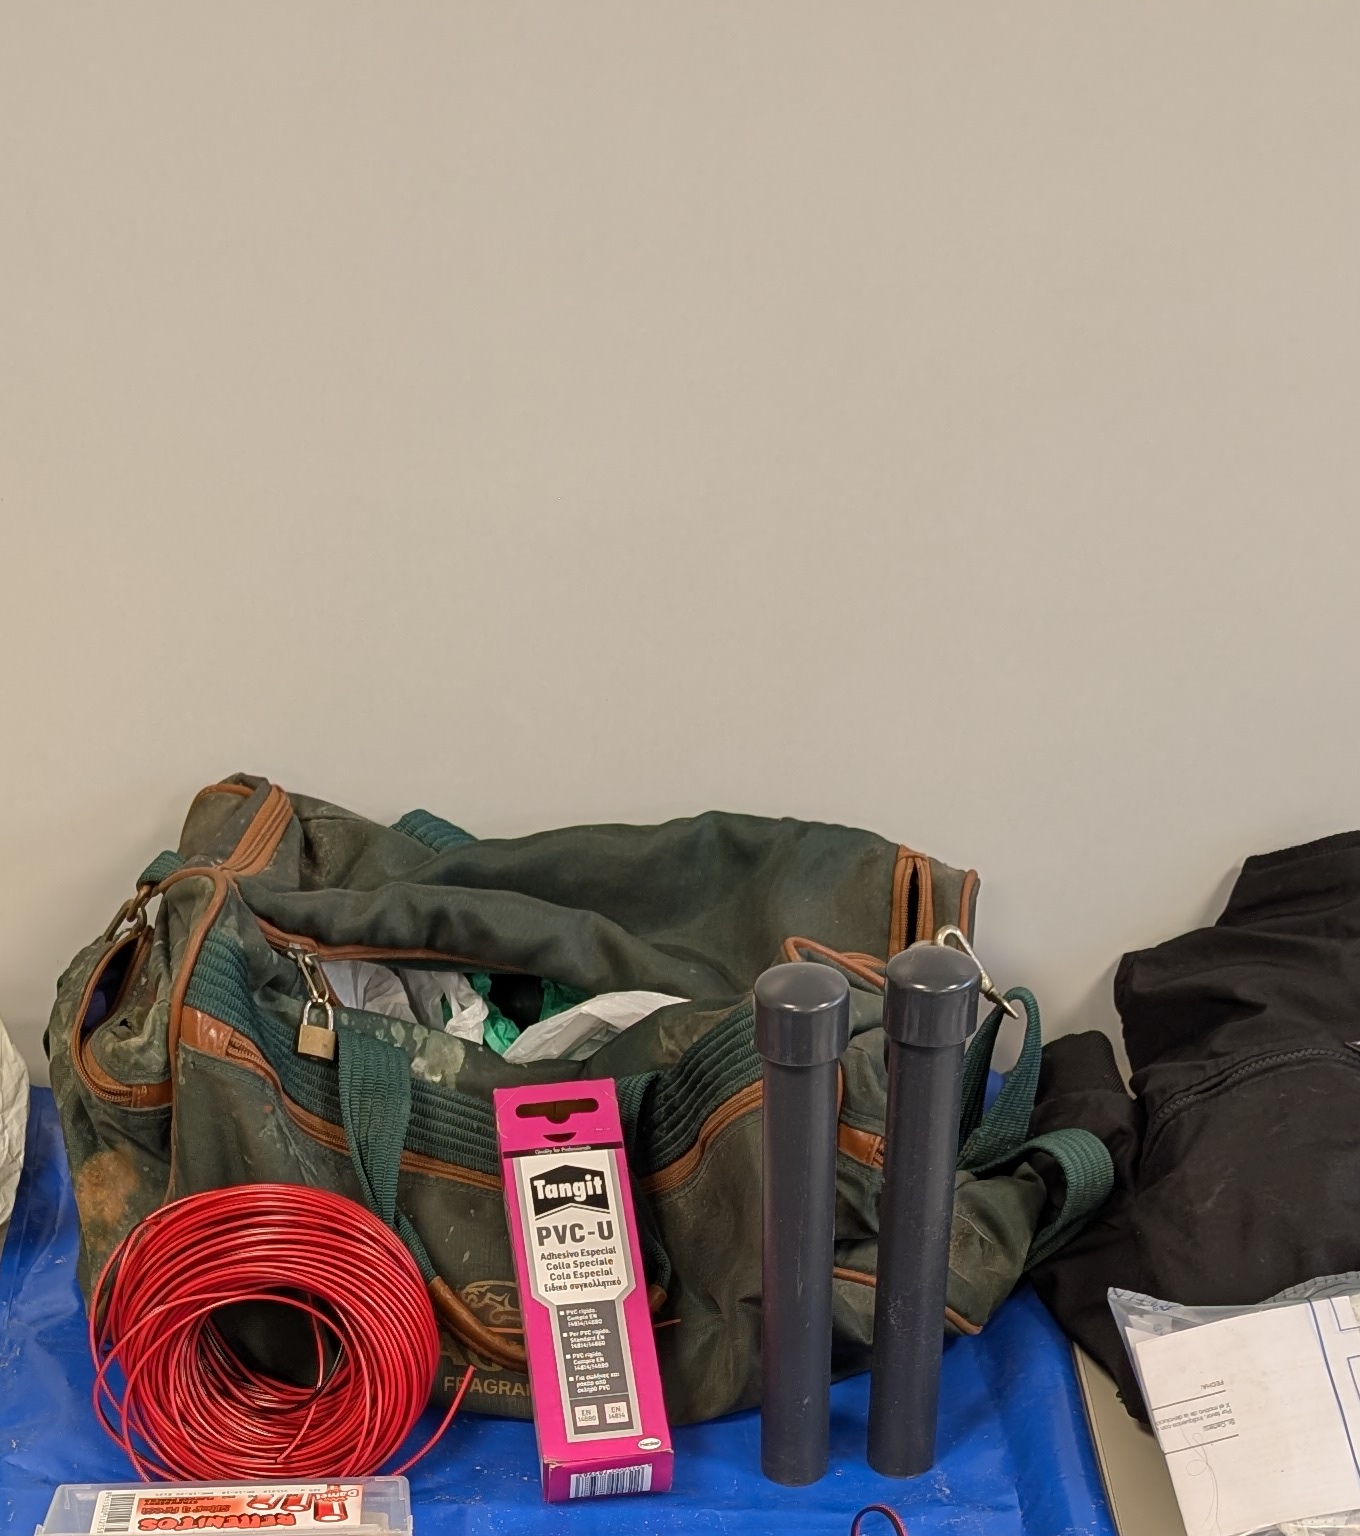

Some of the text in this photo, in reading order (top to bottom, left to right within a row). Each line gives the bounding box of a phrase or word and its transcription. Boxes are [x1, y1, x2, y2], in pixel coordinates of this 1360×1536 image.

[533, 1174, 604, 1202] Tangit
[535, 1220, 615, 1247] PVC-U
[540, 1245, 617, 1262] Adhesivo Especial
[546, 1257, 614, 1271] Colla Speciale
[549, 1267, 614, 1282] Cola Especial
